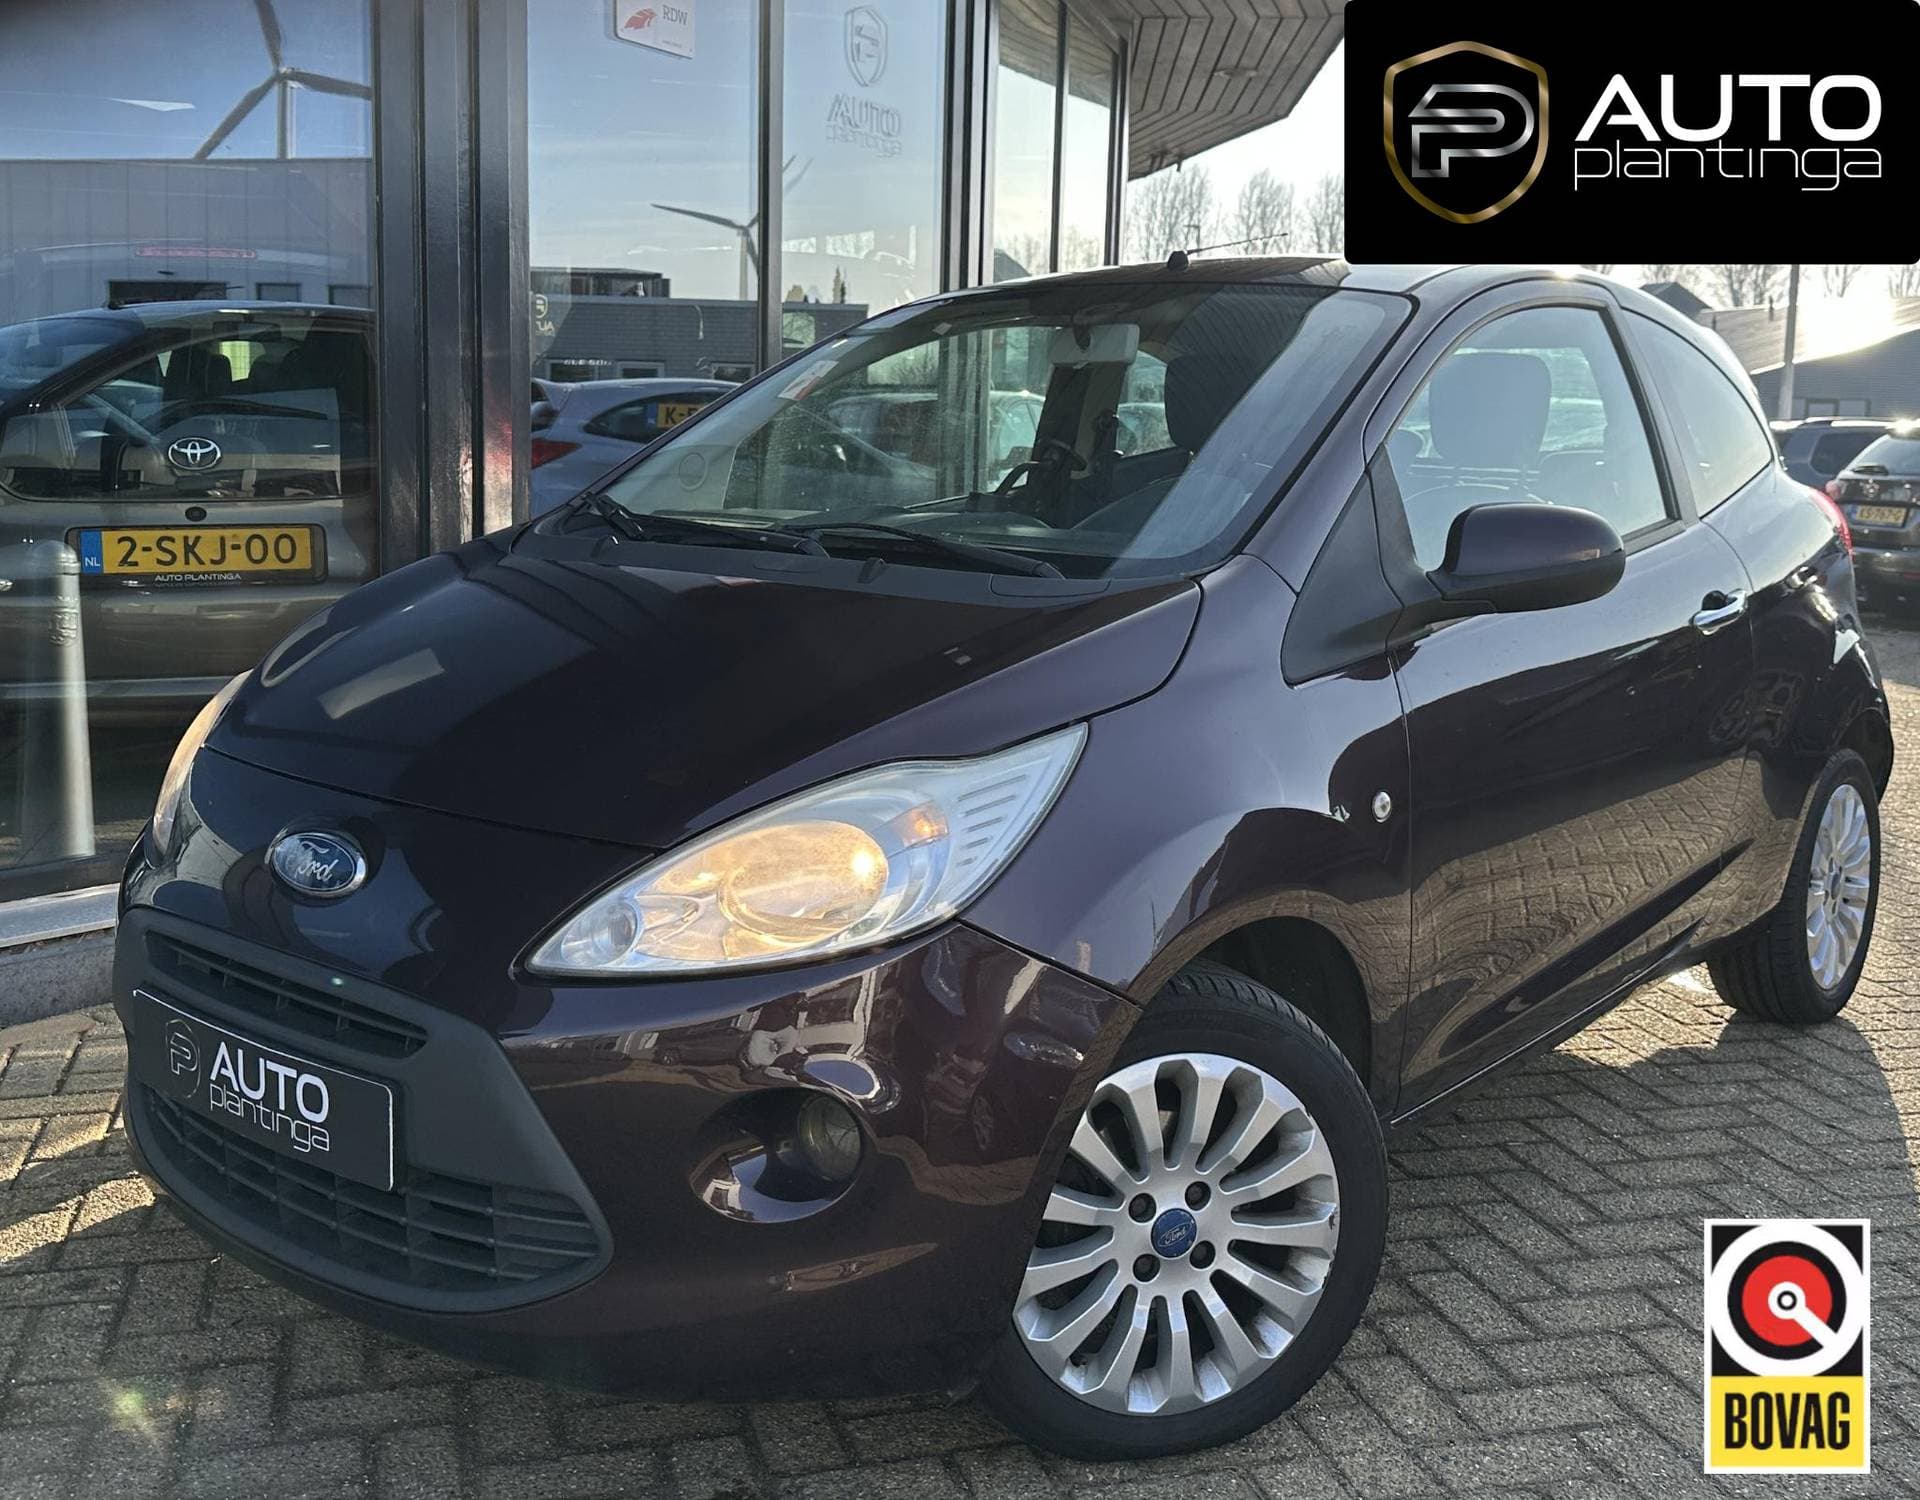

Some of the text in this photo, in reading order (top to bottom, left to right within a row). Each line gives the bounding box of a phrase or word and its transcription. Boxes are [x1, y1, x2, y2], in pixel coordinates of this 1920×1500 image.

[662, 4, 688, 26] RDW
[85, 557, 101, 567] NL
[116, 533, 298, 568] 2-SKJ-00
[154, 572, 242, 582] AUTO PLANTINGA
[285, 840, 340, 882] Ford
[210, 1041, 329, 1123] AUTO
[210, 1083, 330, 1153] plantinga
[1164, 1225, 1188, 1245] Ford
